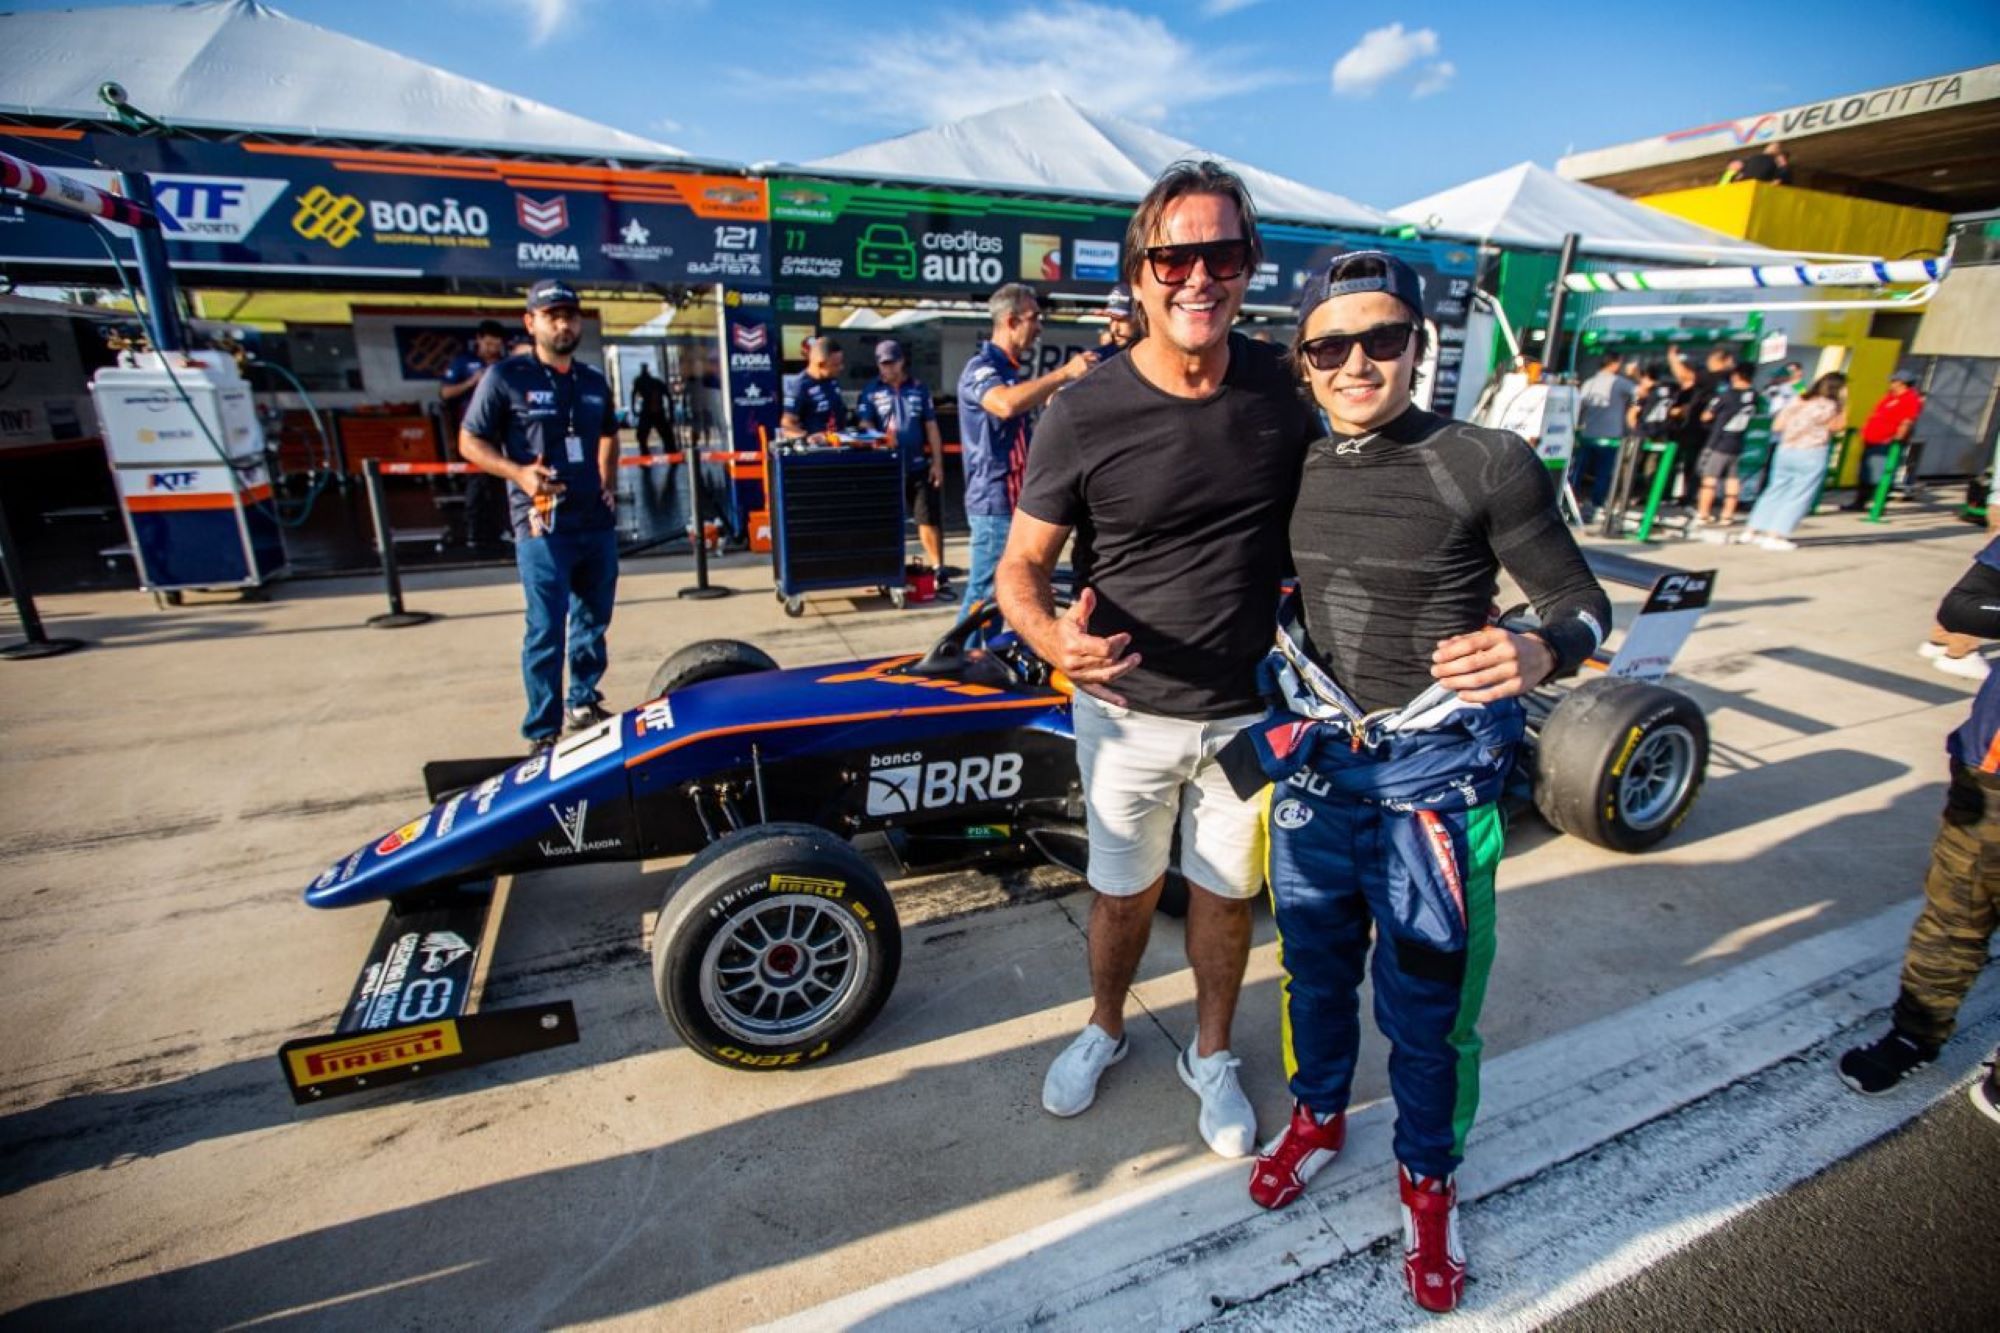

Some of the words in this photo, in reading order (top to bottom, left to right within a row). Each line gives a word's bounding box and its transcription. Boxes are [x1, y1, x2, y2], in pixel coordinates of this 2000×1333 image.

[1782, 76, 1963, 134] VELOCITTA
[370, 197, 489, 236] BOCÃO
[714, 226, 758, 250] 121
[786, 230, 806, 250] 11
[922, 231, 1003, 253] creditas
[517, 242, 580, 262] EVORA
[713, 252, 762, 264] FELIPE
[687, 261, 762, 276] BAPTISTA
[922, 252, 1004, 284] auto
[152, 471, 199, 491] KTF
[870, 751, 923, 768] banco
[922, 752, 1024, 809] BRB
[769, 873, 847, 899] PIRELLI
[305, 1028, 443, 1077] PIRELLI
